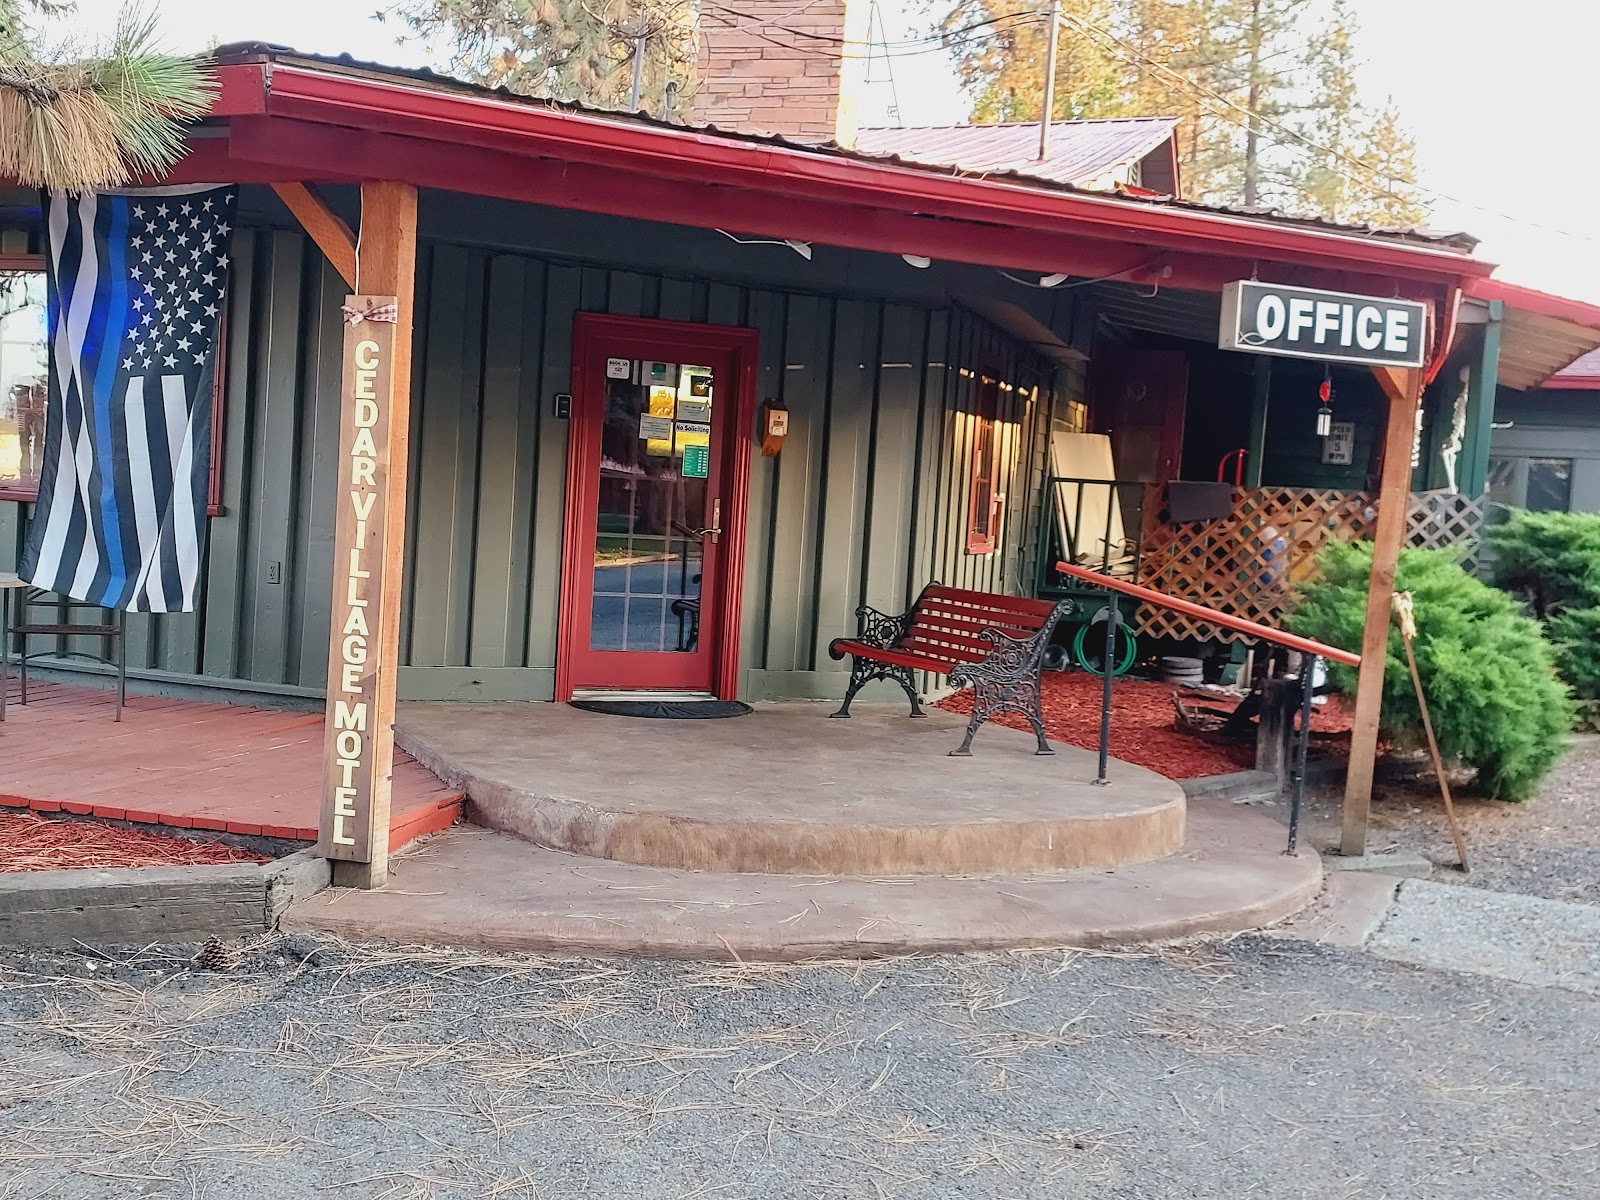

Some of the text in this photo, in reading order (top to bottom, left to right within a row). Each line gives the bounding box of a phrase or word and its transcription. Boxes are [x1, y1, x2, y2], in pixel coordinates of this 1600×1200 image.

[1256, 294, 1410, 353] OFFICE
[684, 424, 709, 434] Soliciting
[1334, 442, 1341, 451] 5
[332, 339, 380, 846] CEDAR VILLAGE MOTEL
